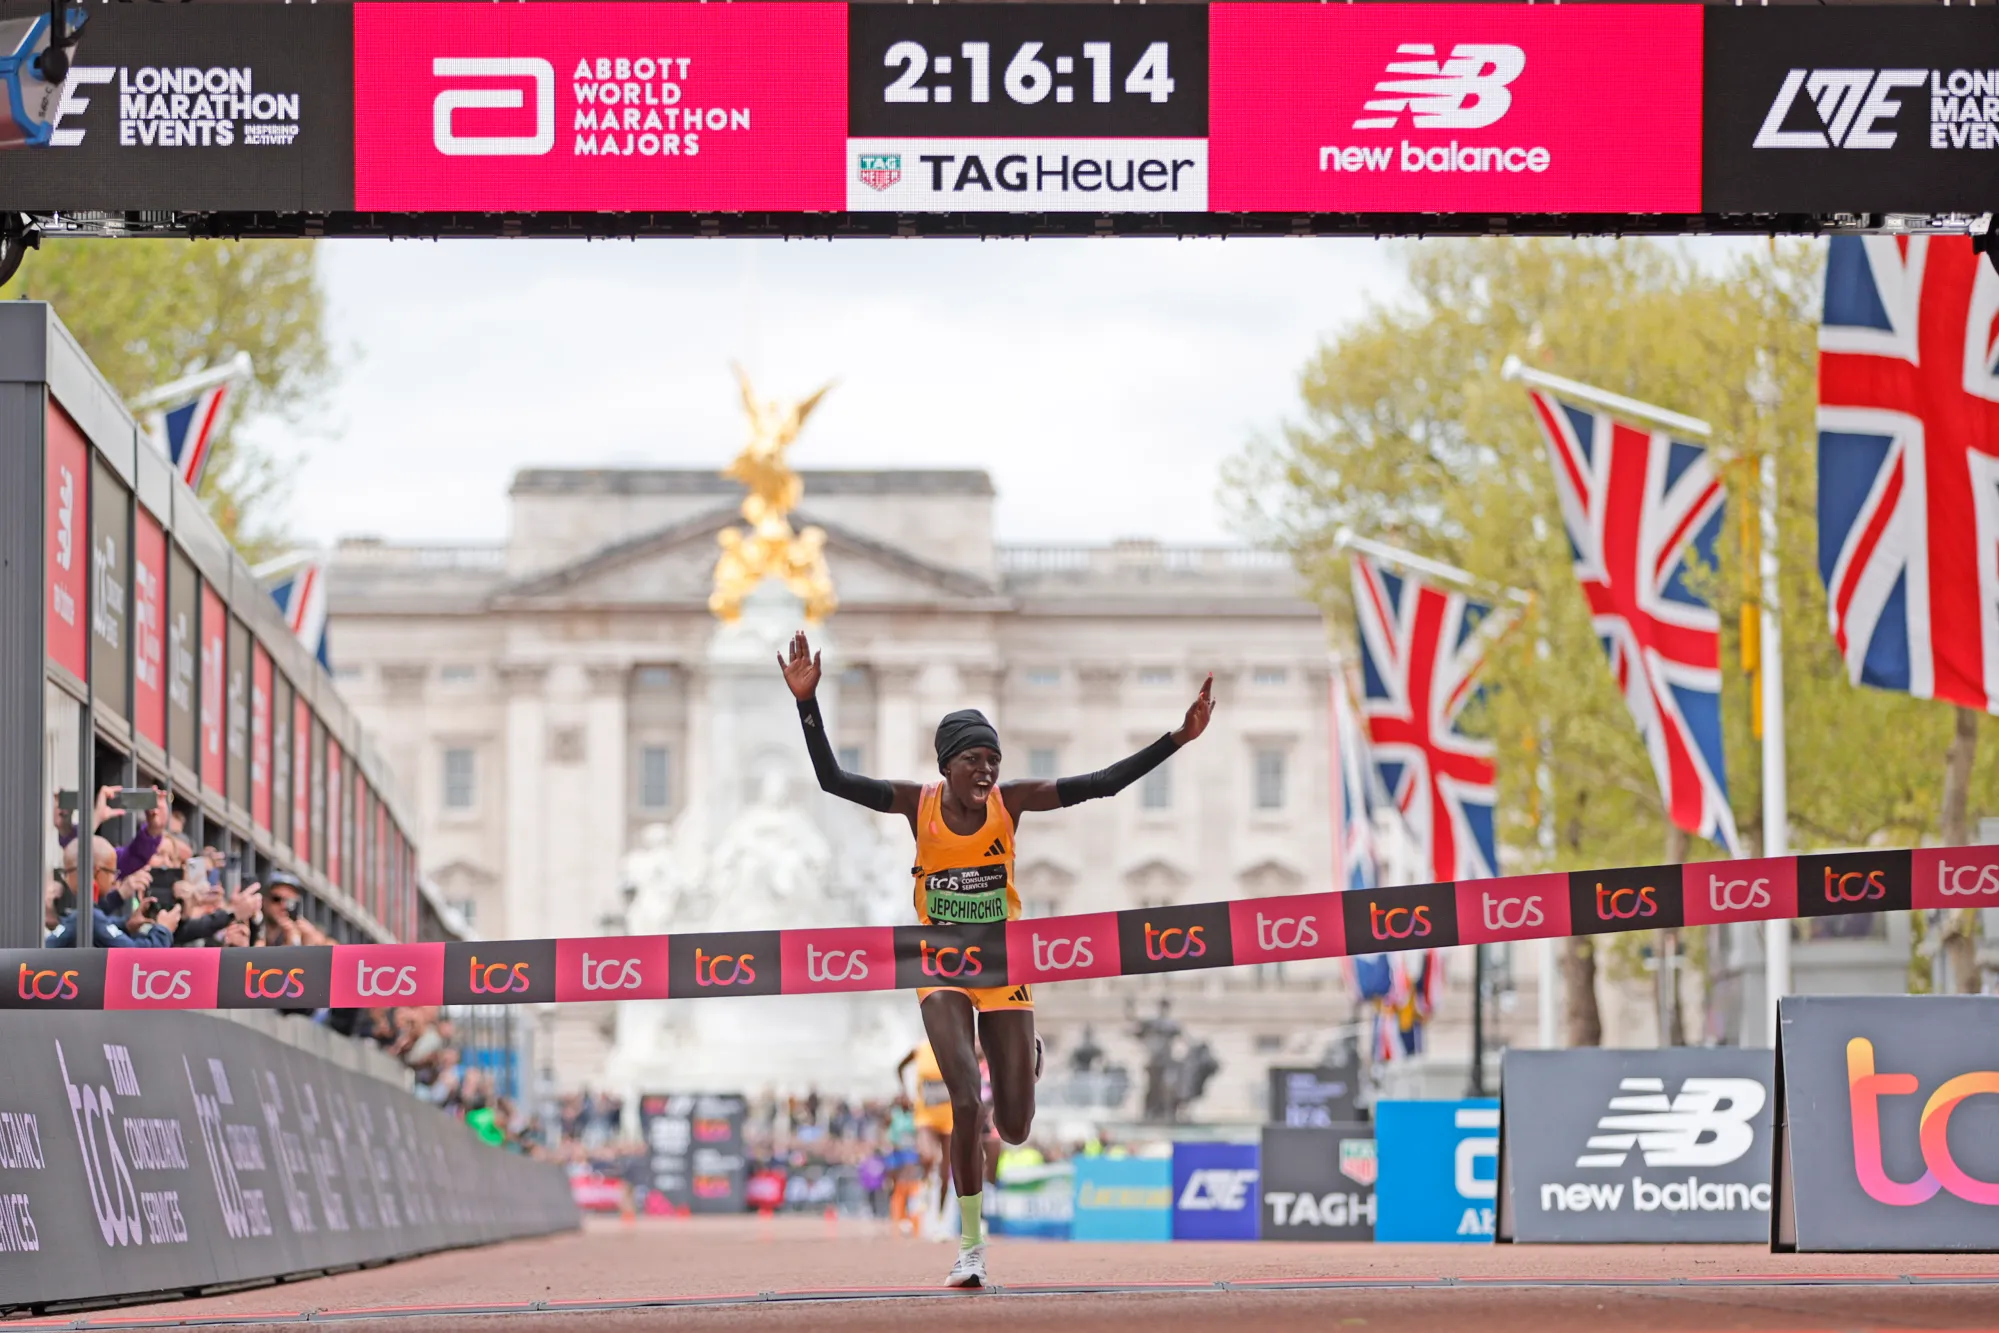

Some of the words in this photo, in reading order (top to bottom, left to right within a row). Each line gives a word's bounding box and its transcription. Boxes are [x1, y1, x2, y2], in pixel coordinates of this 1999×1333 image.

[120, 67, 252, 94] LONDON
[574, 58, 690, 80] ABBOTT
[884, 42, 1175, 105] 2:16:14
[574, 83, 682, 105] WORLD
[1930, 69, 1999, 97] LON
[120, 94, 299, 120] MARATHON
[244, 124, 299, 135] INSPIRING
[574, 108, 750, 131] MARATHON
[120, 120, 235, 147] EVENTS
[244, 135, 294, 145] ACTIVITY
[574, 134, 699, 156] MAJORS
[862, 158, 898, 169] TAG
[1319, 146, 1394, 172] new
[1401, 139, 1550, 173] balance
[961, 875, 1003, 884] CONSULTANCY
[961, 882, 988, 891] SERVICES
[930, 897, 1003, 920] JEPCHIRCHIR
[18, 963, 78, 1000] tcs
[131, 963, 191, 999] tcs
[244, 961, 304, 998] tcs
[357, 959, 417, 996] tcs
[470, 956, 529, 994] tcs
[582, 953, 641, 990] tcs
[695, 948, 755, 986] tcs
[807, 944, 868, 981] tcs
[921, 940, 982, 977] tcs
[1033, 933, 1094, 971] tcs
[1145, 922, 1206, 960] tcs
[1257, 912, 1319, 950] tcs
[1370, 902, 1432, 940] tcs
[1482, 892, 1544, 930] tcs
[1596, 882, 1657, 920] tcs
[1709, 874, 1770, 911] tcs
[1824, 866, 1886, 902] tcs
[1938, 860, 1999, 895] tcs
[1540, 1183, 1624, 1211] new
